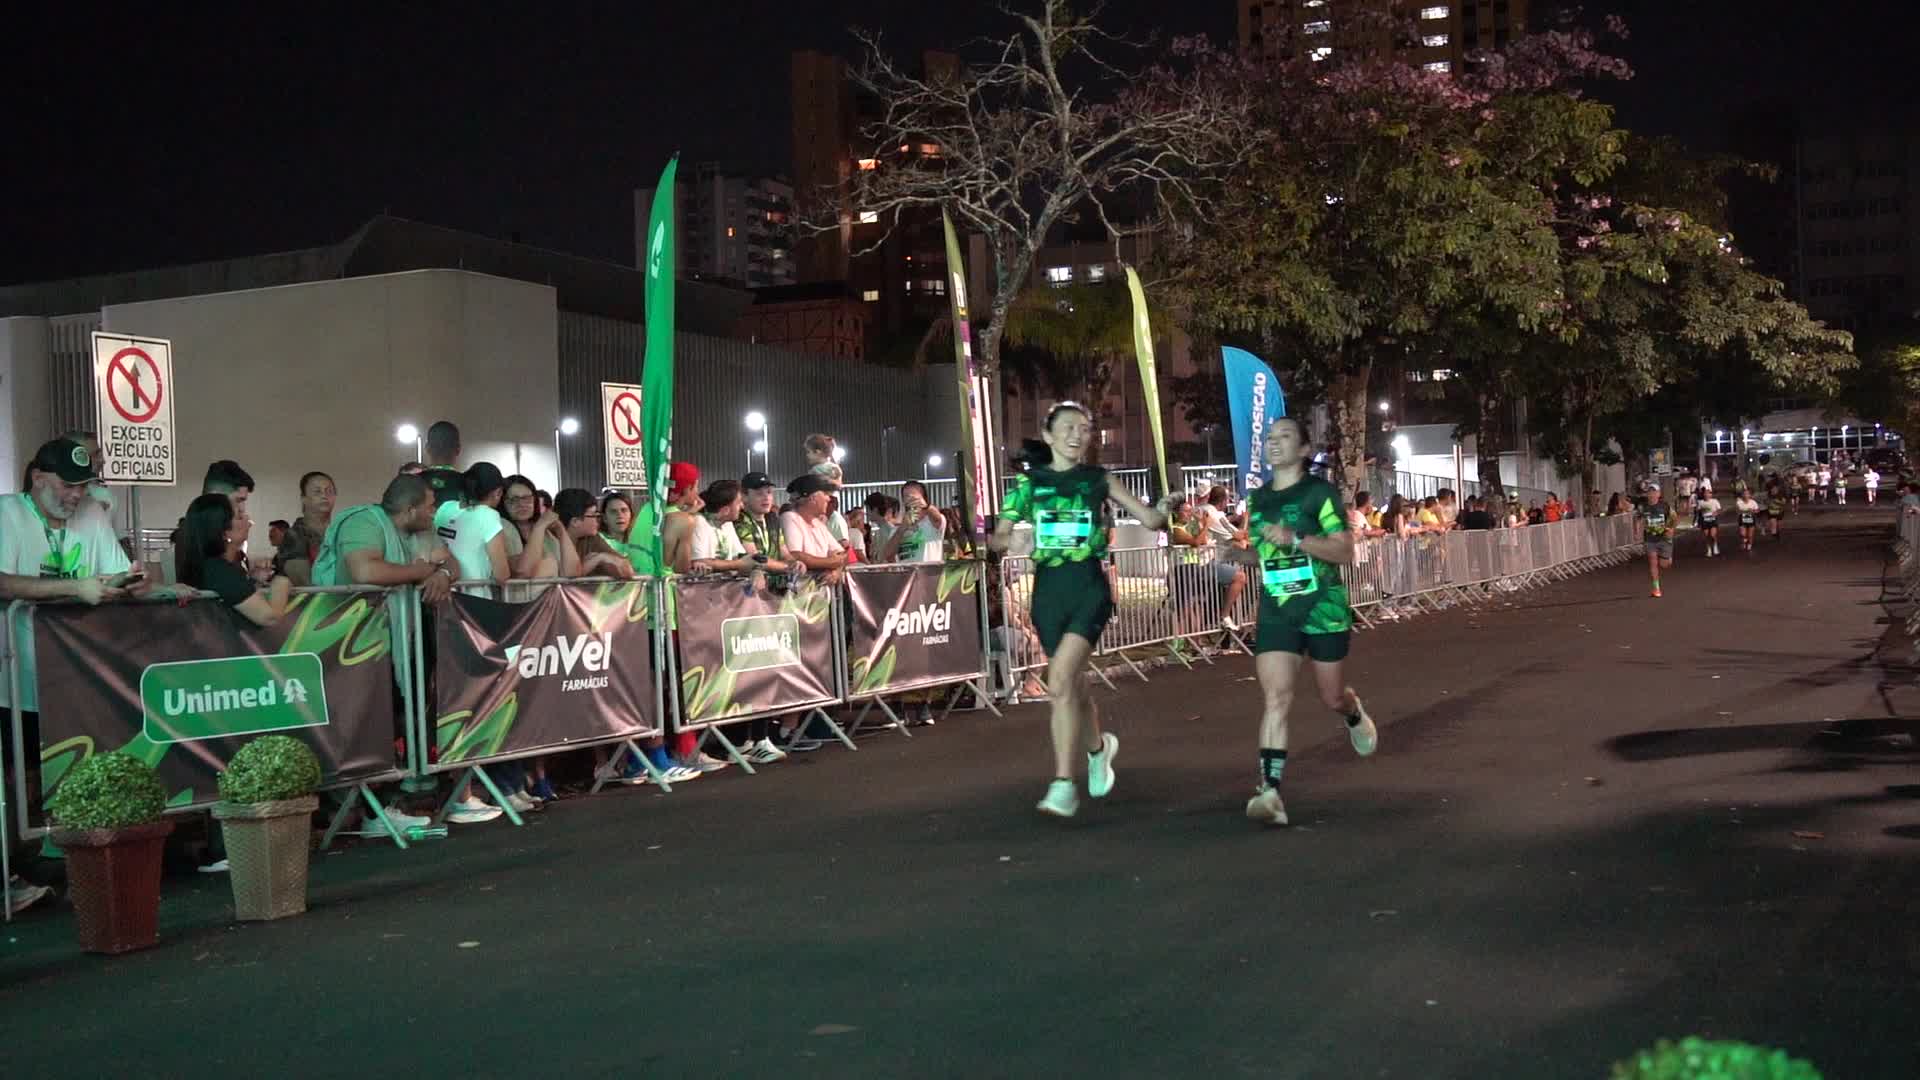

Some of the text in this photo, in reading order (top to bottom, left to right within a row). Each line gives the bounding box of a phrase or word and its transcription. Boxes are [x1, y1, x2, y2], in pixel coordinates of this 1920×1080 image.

[111, 425, 163, 441] EXCETO
[105, 441, 169, 459] VEÍCULOS
[614, 447, 640, 459] EXCET
[111, 461, 165, 476] OFICIAIS
[882, 602, 951, 636] PanVel
[561, 674, 609, 692] FARMÁCIAS
[163, 679, 276, 716] Unimed
